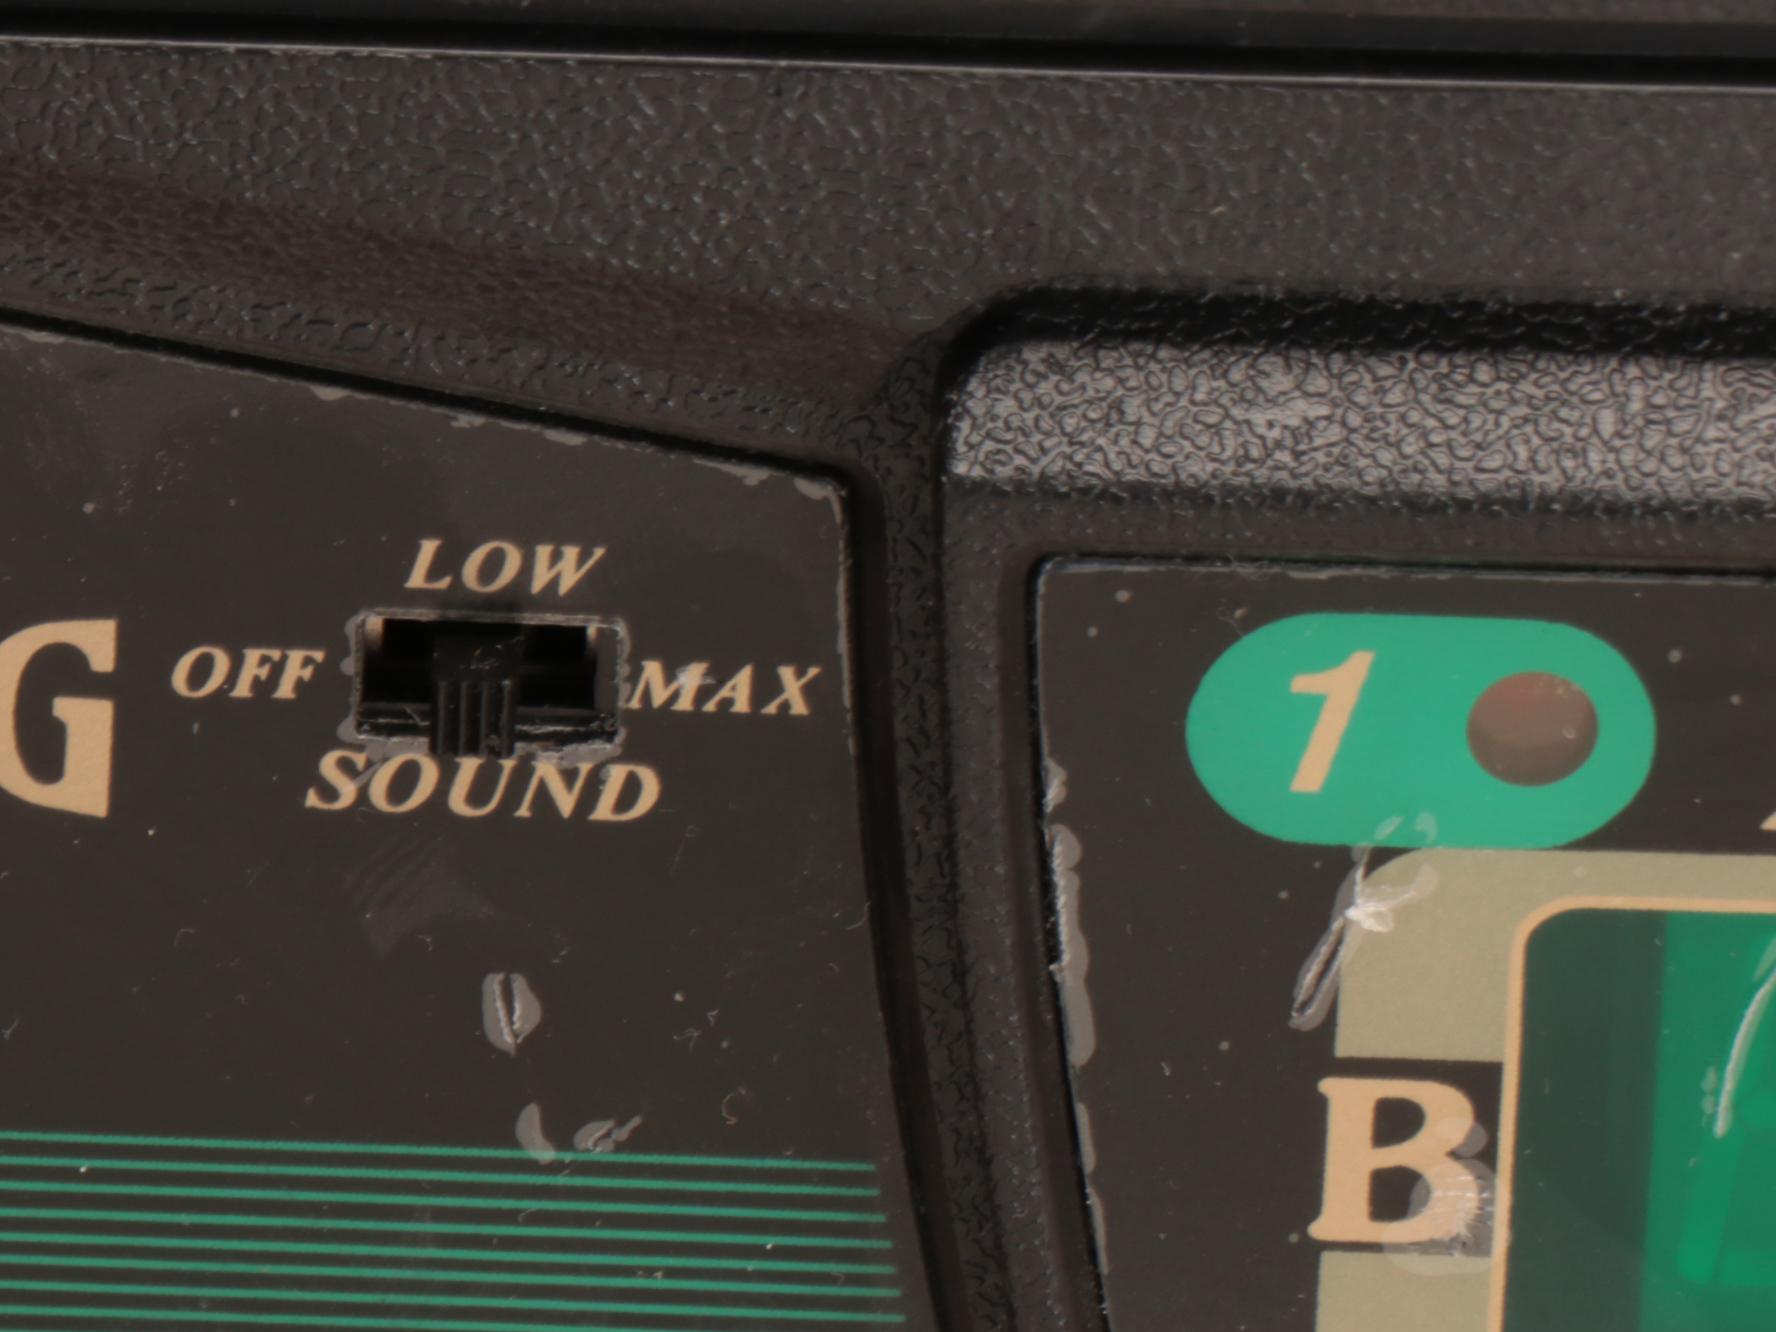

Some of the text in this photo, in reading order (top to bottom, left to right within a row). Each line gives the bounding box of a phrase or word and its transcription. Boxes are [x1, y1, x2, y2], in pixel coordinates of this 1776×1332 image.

[404, 538, 606, 597] LOW
[171, 645, 326, 700] OFF
[627, 660, 822, 715] MAX
[1289, 650, 1375, 793] 1
[304, 749, 662, 822] SOUND
[1308, 1075, 1481, 1243] B
